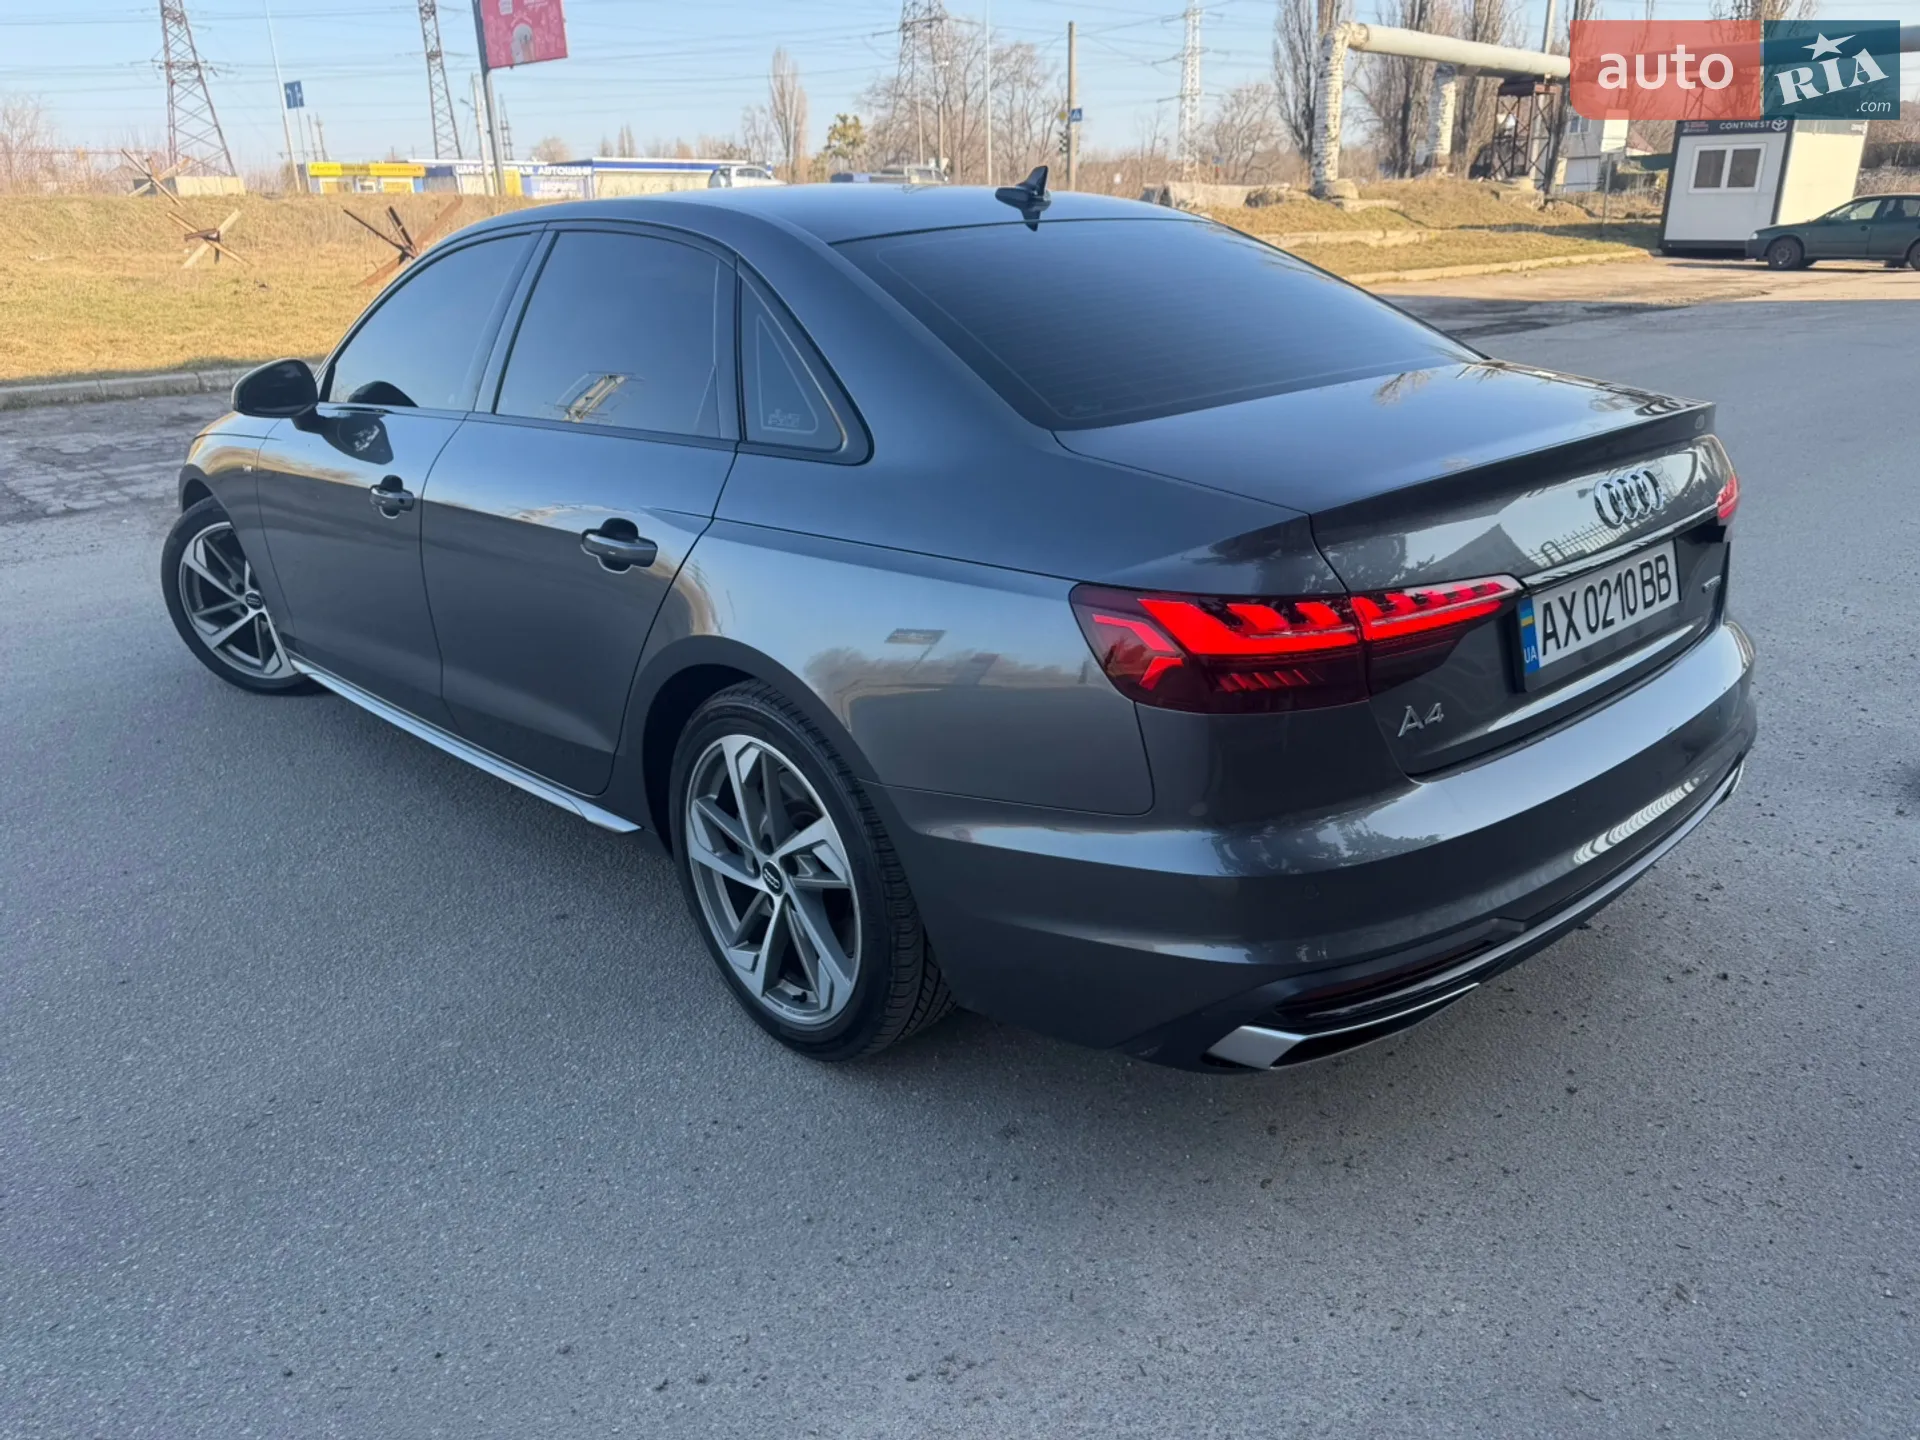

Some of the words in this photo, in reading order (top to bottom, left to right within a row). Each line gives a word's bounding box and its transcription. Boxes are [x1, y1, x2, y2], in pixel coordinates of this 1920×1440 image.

[1719, 121, 1771, 130] CONTINEST
[1584, 568, 1637, 634] 0210
[1524, 645, 1538, 664] UA
[1398, 703, 1444, 737] A4
